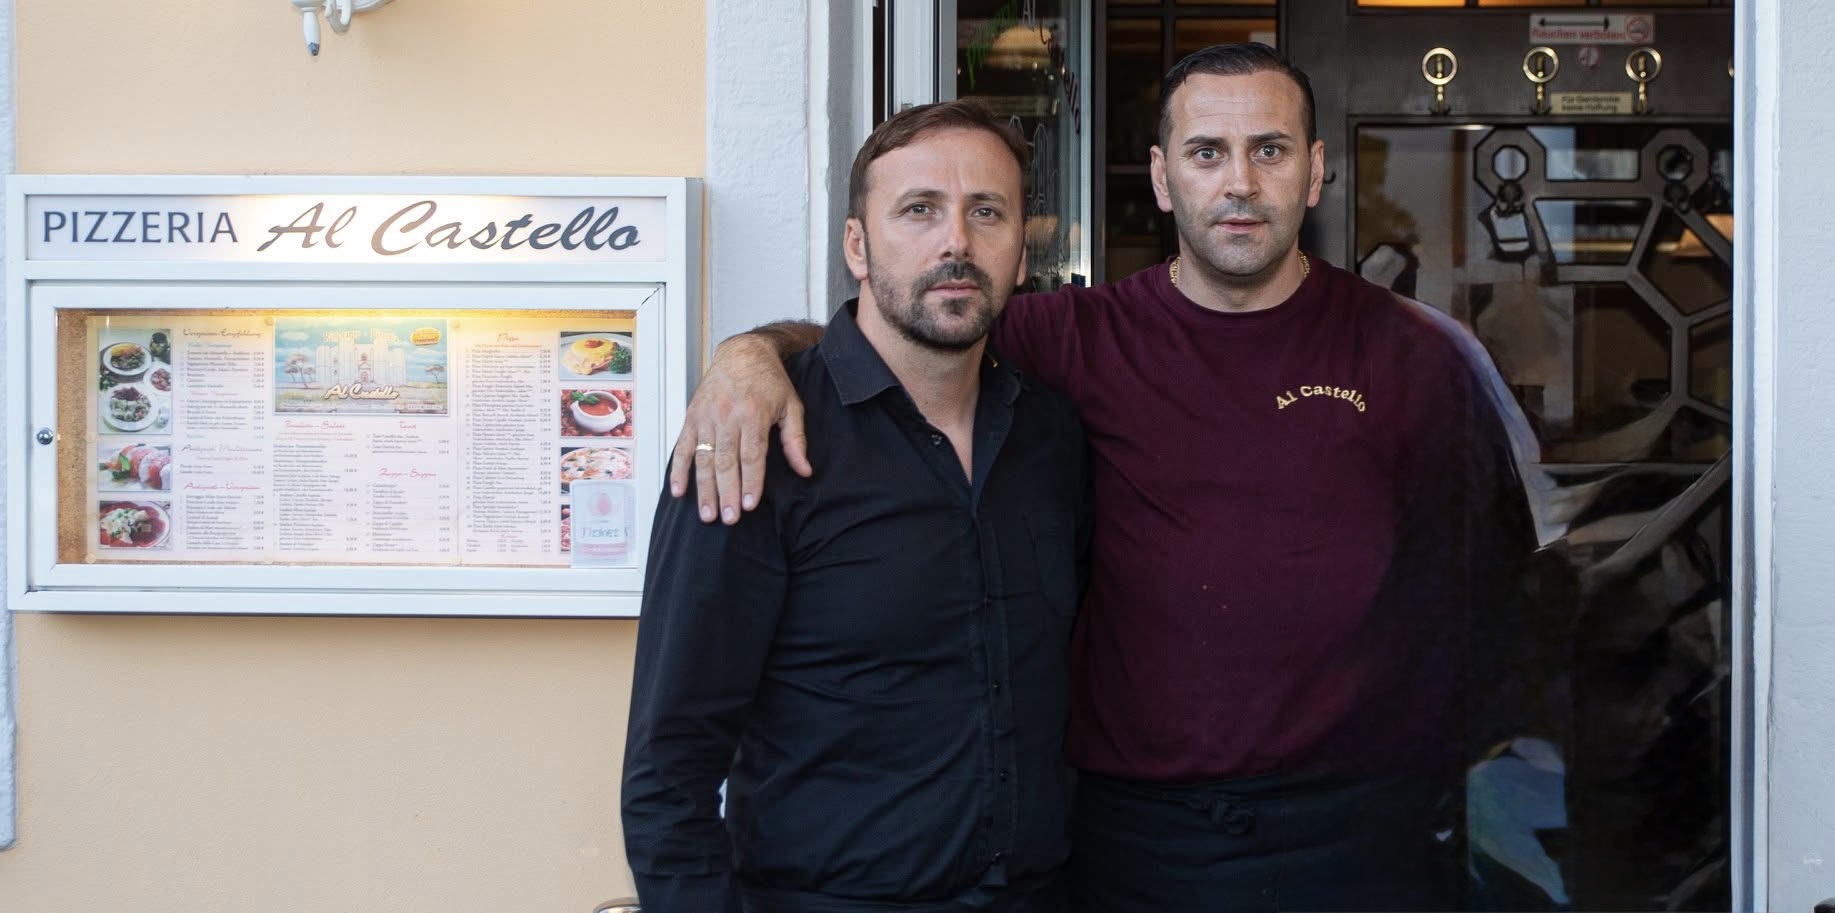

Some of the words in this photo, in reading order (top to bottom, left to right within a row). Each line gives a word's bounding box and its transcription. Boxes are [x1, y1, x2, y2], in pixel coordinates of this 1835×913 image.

[43, 210, 238, 243] PIZZERIA
[257, 201, 357, 252] Al
[370, 199, 641, 256] Castello
[1276, 390, 1299, 410] Al
[1300, 385, 1366, 412] Castello
